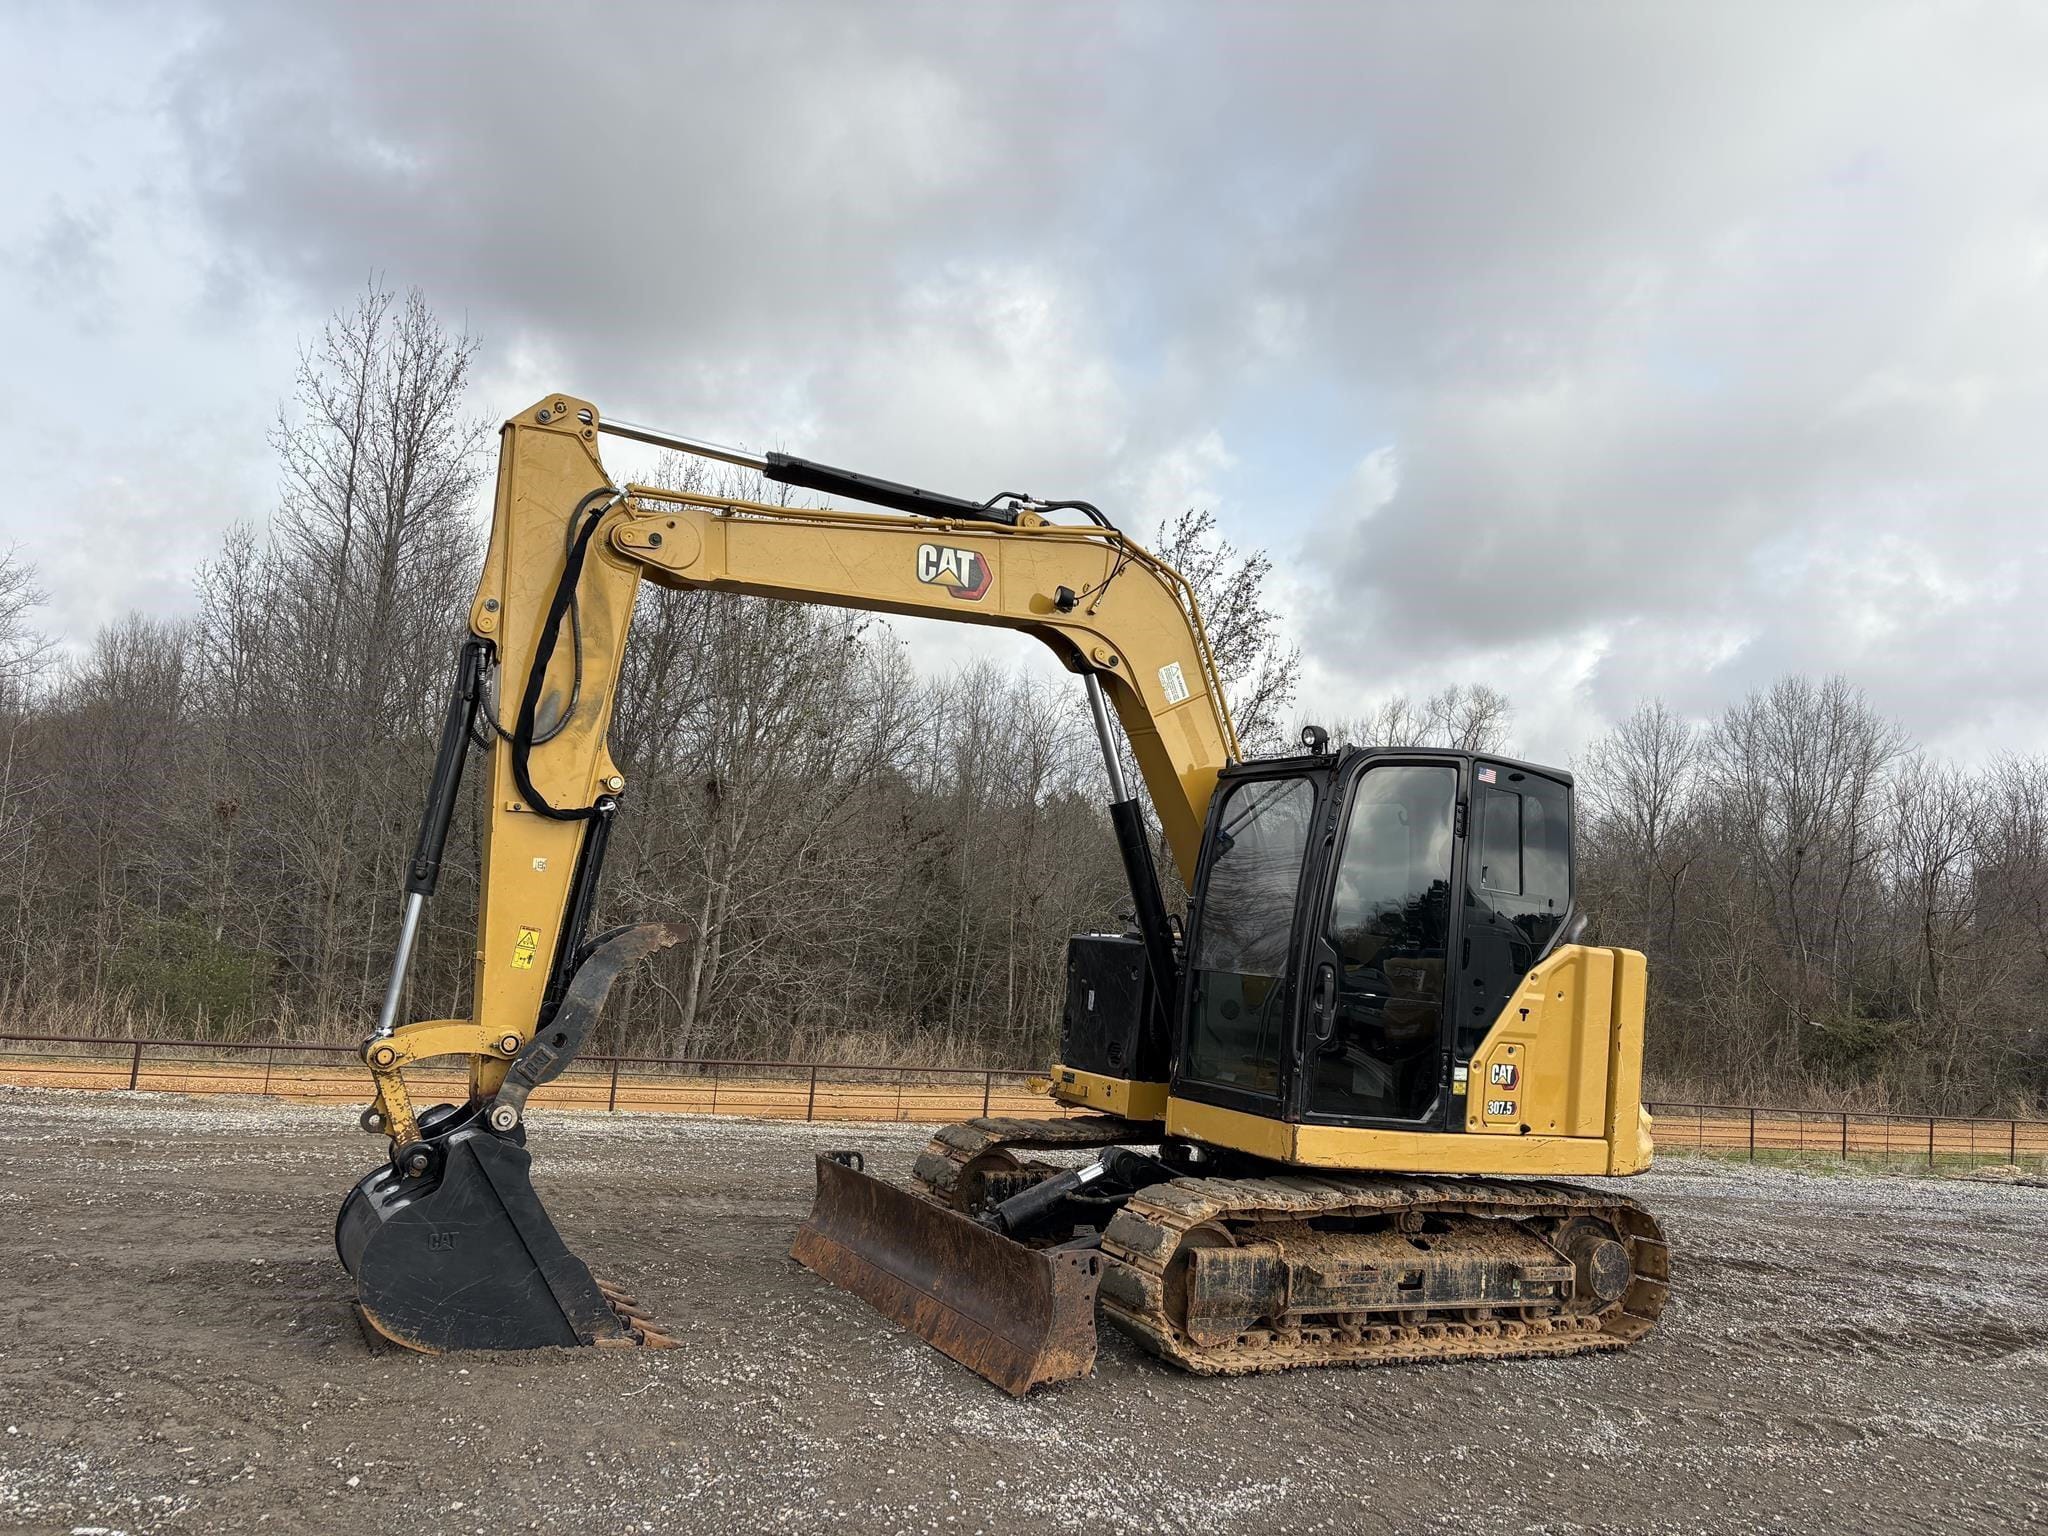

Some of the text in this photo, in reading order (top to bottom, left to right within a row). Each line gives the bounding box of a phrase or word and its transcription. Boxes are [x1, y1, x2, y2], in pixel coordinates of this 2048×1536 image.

[918, 544, 975, 588] CAT
[1491, 1064, 1514, 1085] CAT
[1487, 1101, 1513, 1115] 307.5
[427, 1231, 460, 1251] CAT
